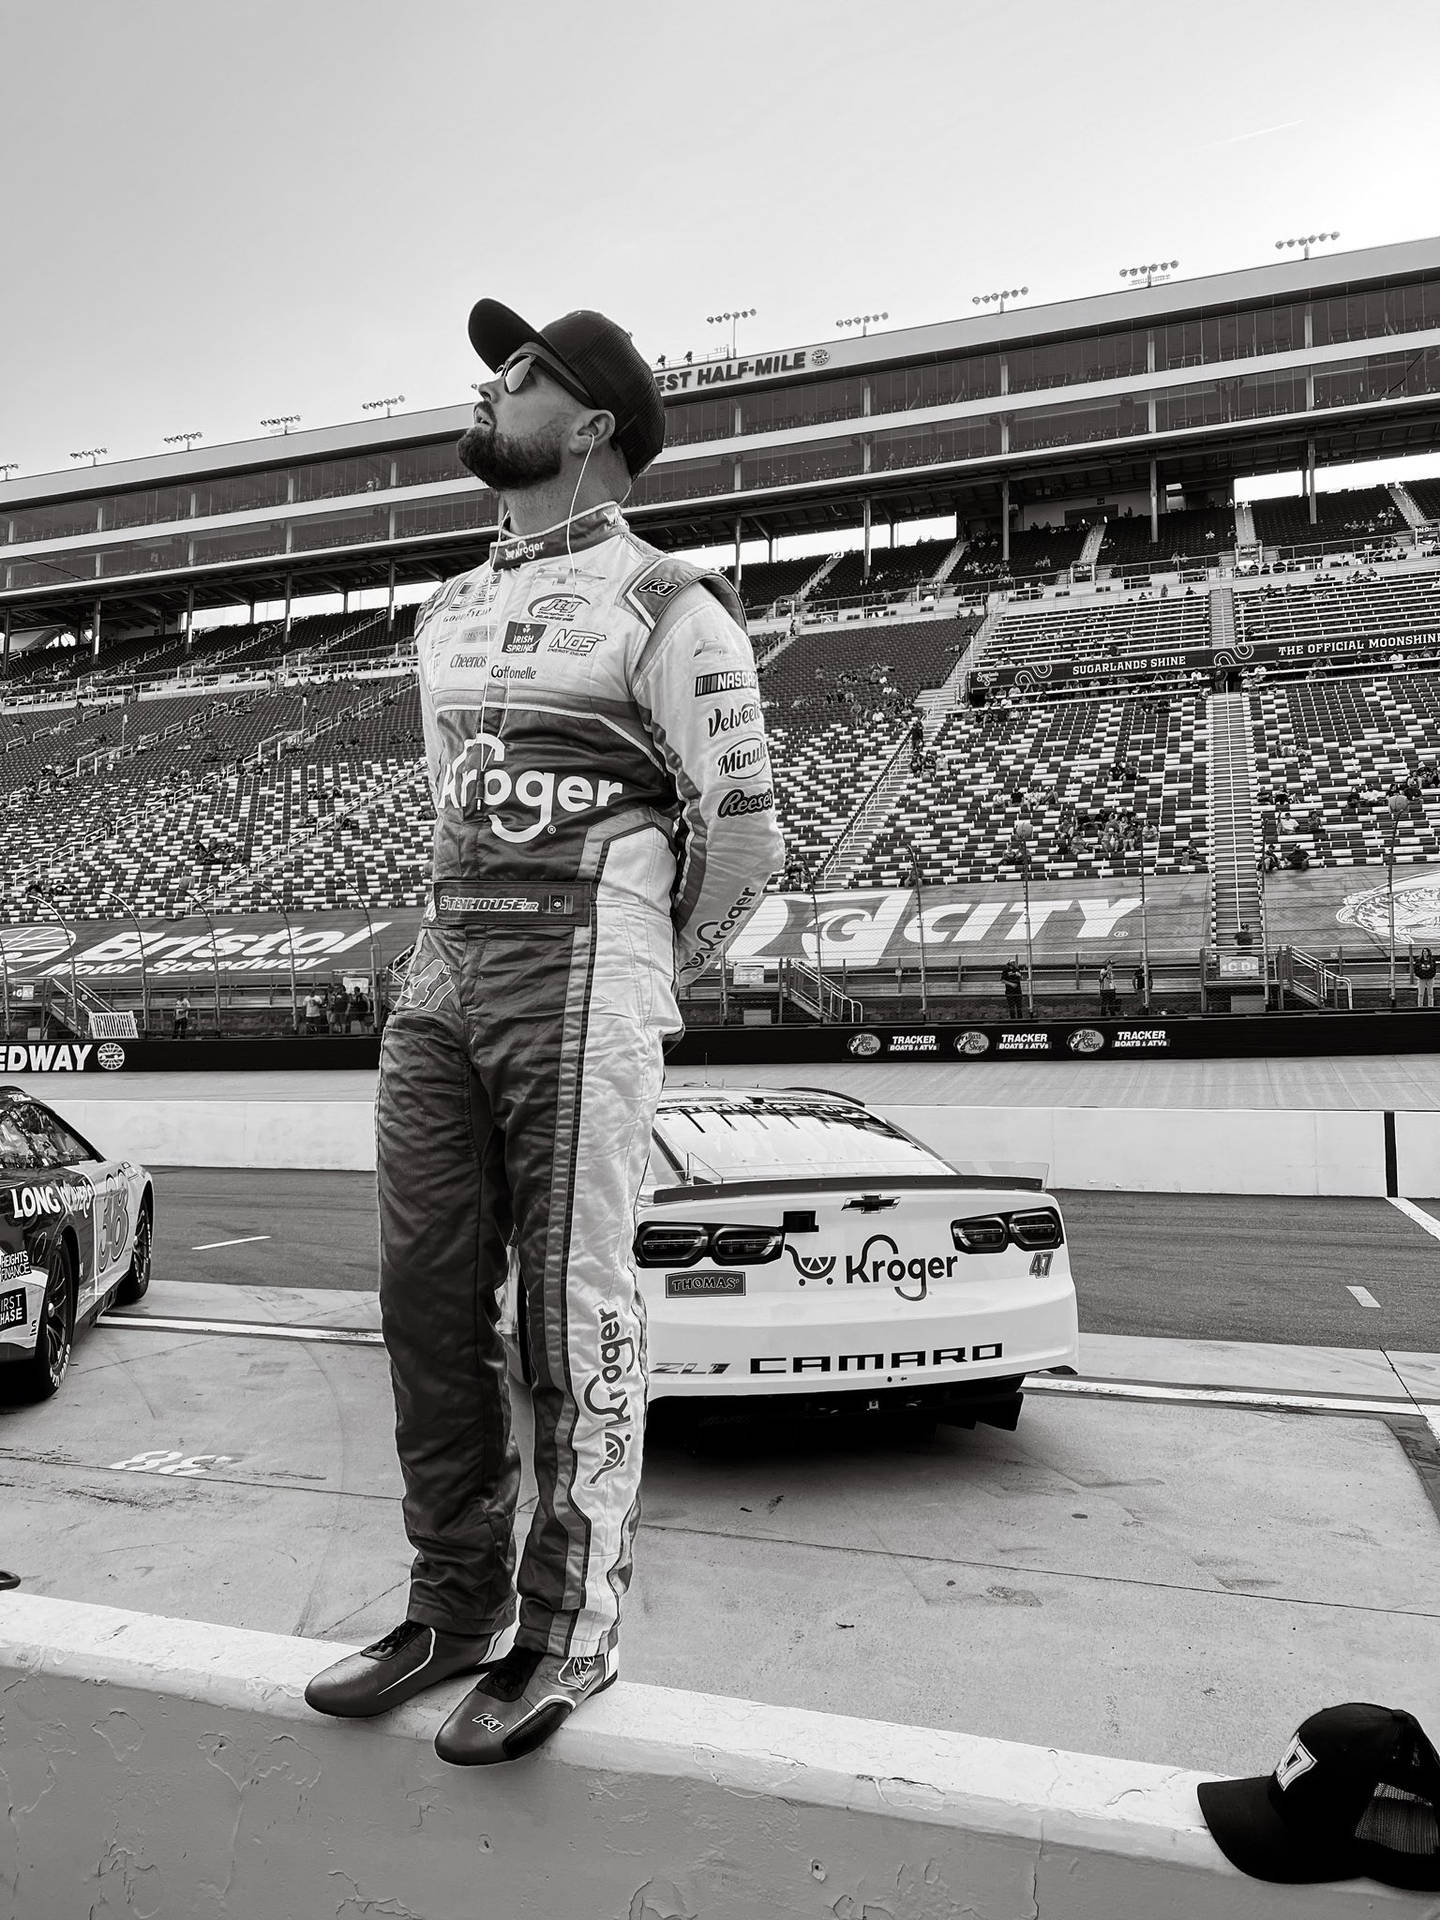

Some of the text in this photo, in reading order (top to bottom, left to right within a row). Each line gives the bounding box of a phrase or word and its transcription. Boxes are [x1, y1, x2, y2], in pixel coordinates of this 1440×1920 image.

[698, 352, 805, 386] HALF-MILE
[506, 643, 534, 653] SPRING
[512, 635, 534, 644] IRISH
[549, 628, 607, 653] NOS
[1278, 645, 1304, 656] THE
[1307, 639, 1365, 654] OFFICIAL
[1072, 656, 1186, 675] SUGARLANDS SHINE
[903, 898, 1148, 943] CITY
[68, 922, 392, 961] Bristol
[37, 957, 330, 976] Motor Speedway
[892, 1035, 936, 1044] TRACKER
[1002, 1033, 1048, 1043] TRACKER
[1114, 1039, 1140, 1048] BOATS
[1117, 1030, 1166, 1040] TRACKER
[999, 1042, 1024, 1050] BOATS
[10, 1185, 61, 1219] LONG
[846, 1234, 958, 1301] Kroger
[1029, 1251, 1053, 1279] 47
[584, 1308, 634, 1427] Kroger
[650, 1343, 1003, 1375] ZL1 CAMARO
